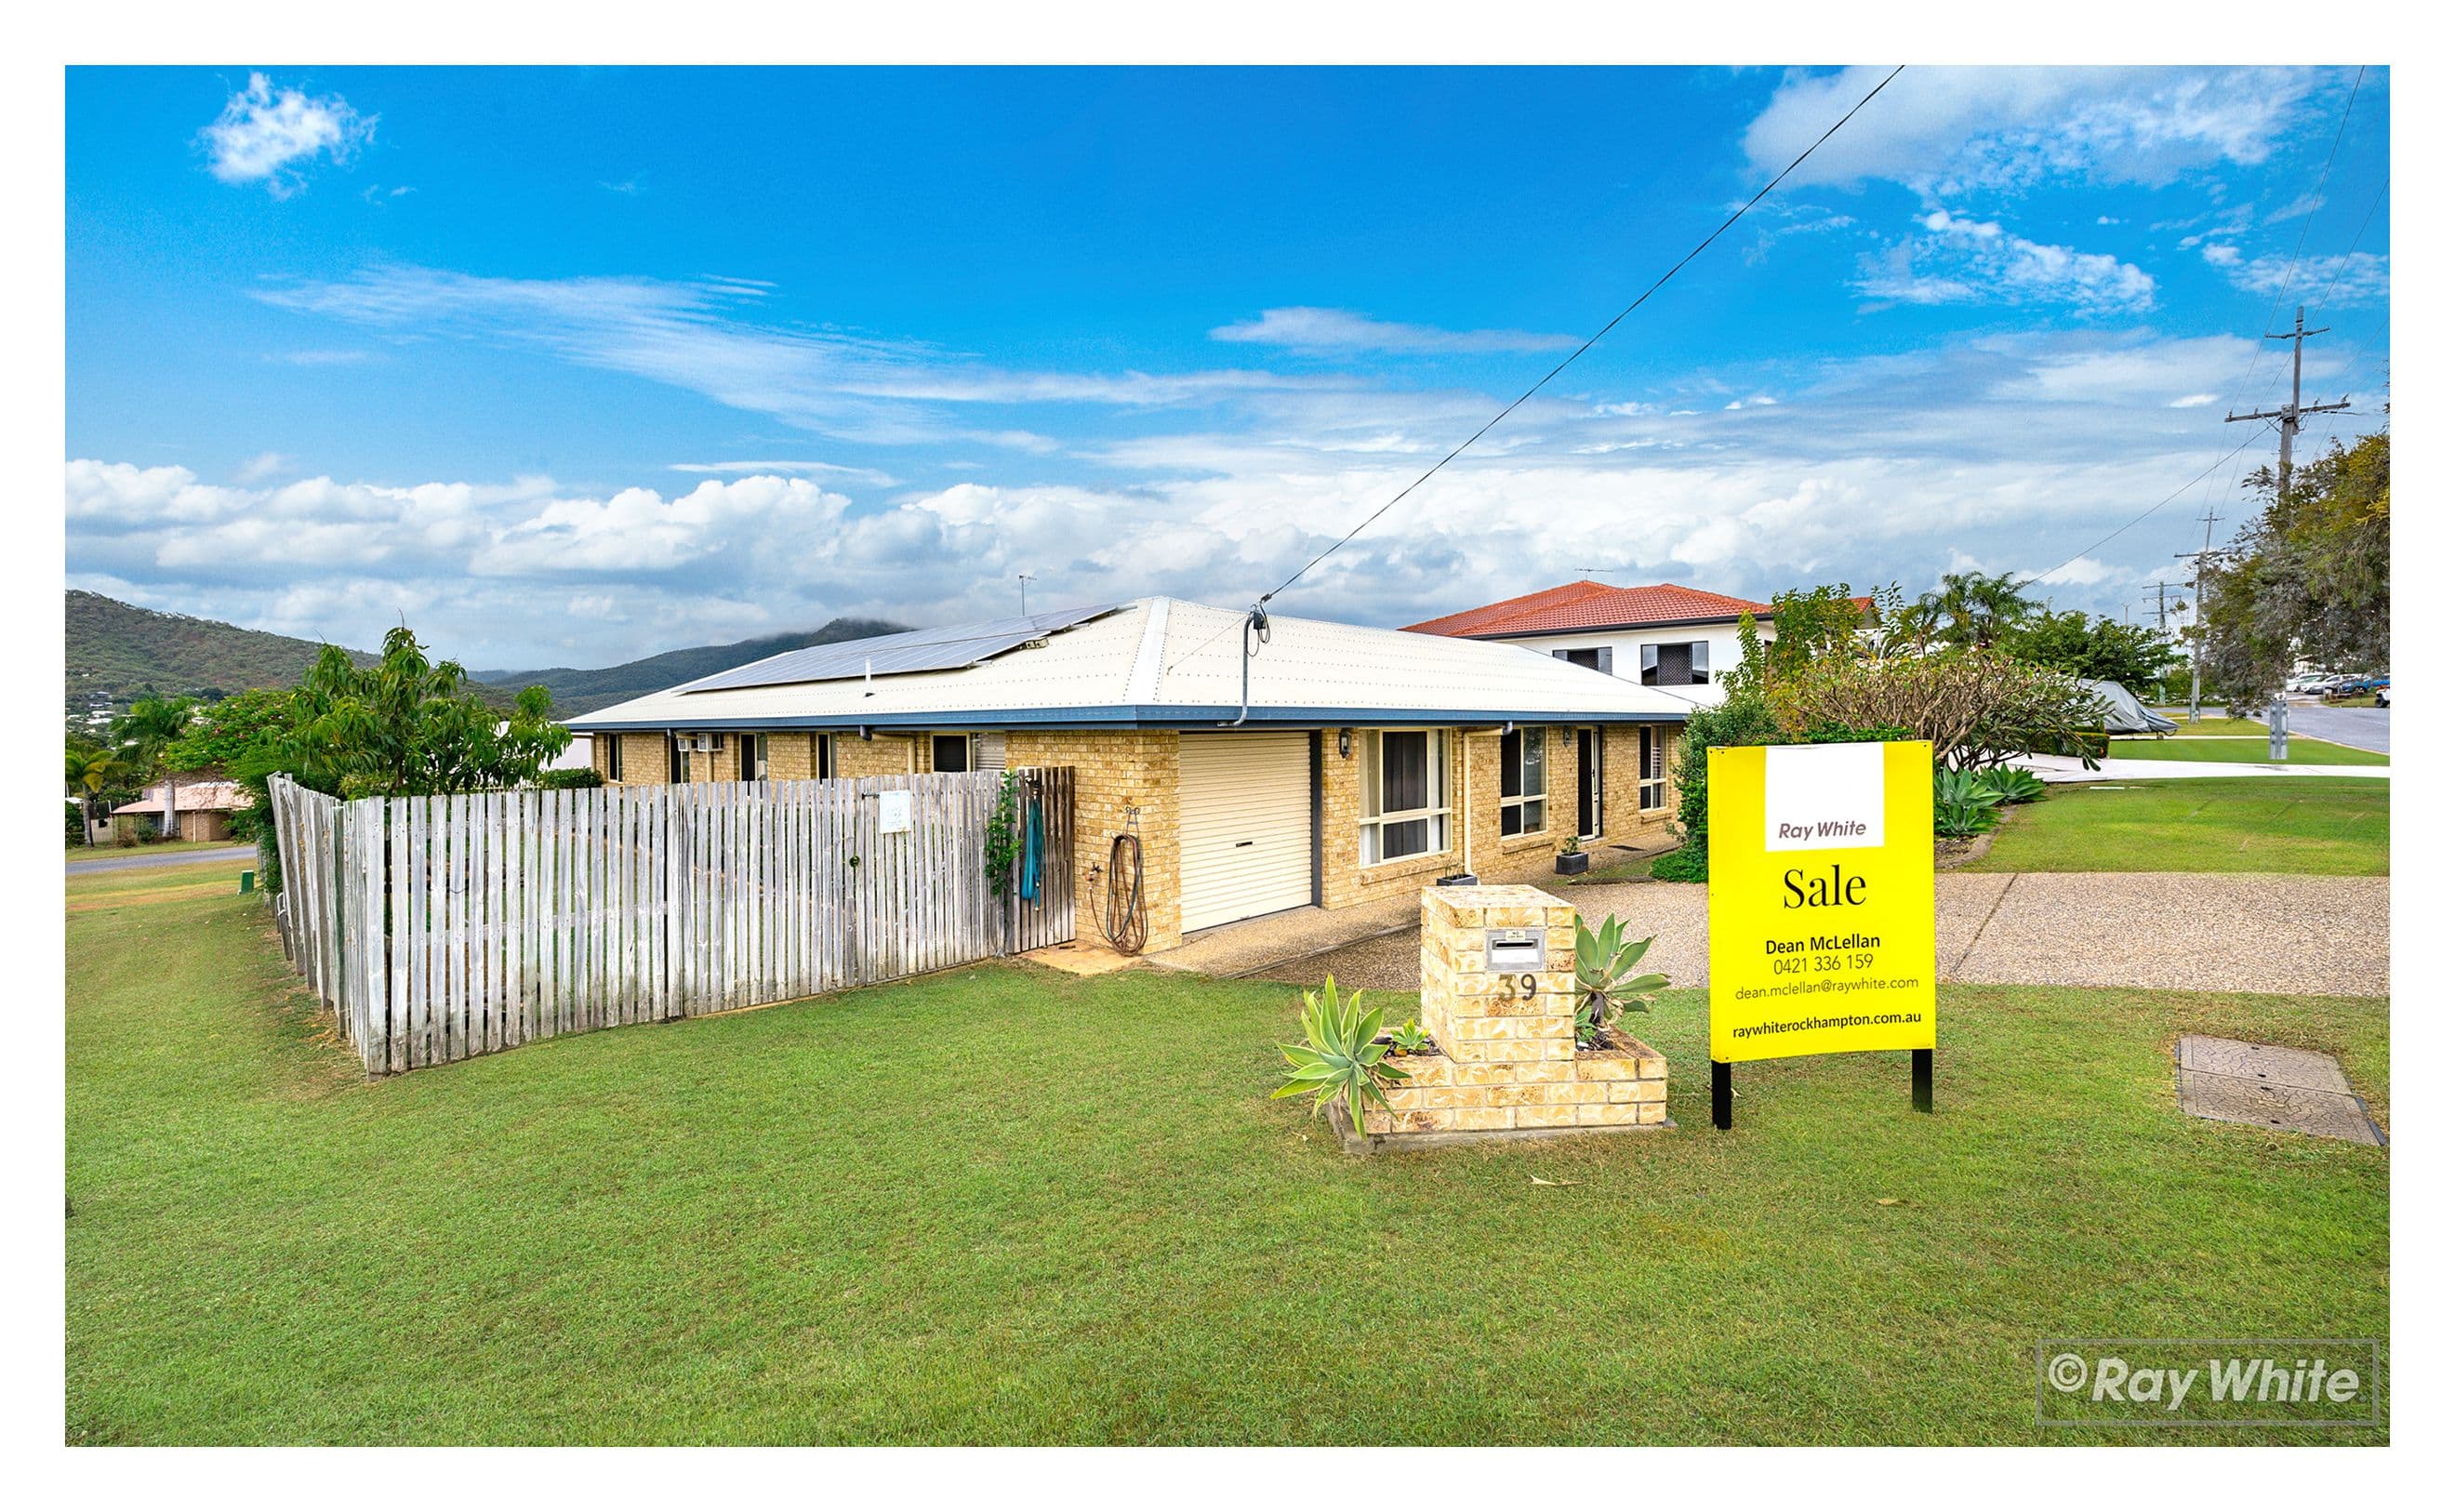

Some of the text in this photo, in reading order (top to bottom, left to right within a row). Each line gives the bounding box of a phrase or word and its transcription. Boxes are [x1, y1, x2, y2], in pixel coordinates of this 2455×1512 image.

[1778, 820, 1866, 842] Ray White
[1784, 864, 1866, 909] Sale
[1765, 933, 1880, 955] Dean McLellan
[1773, 953, 1874, 975] 0421 336 159
[1497, 973, 1537, 1001] 39
[1735, 976, 1919, 1001] dean.mclellan@raywhite.com
[1732, 1012, 1922, 1039] raywhiterockhampton.com.au
